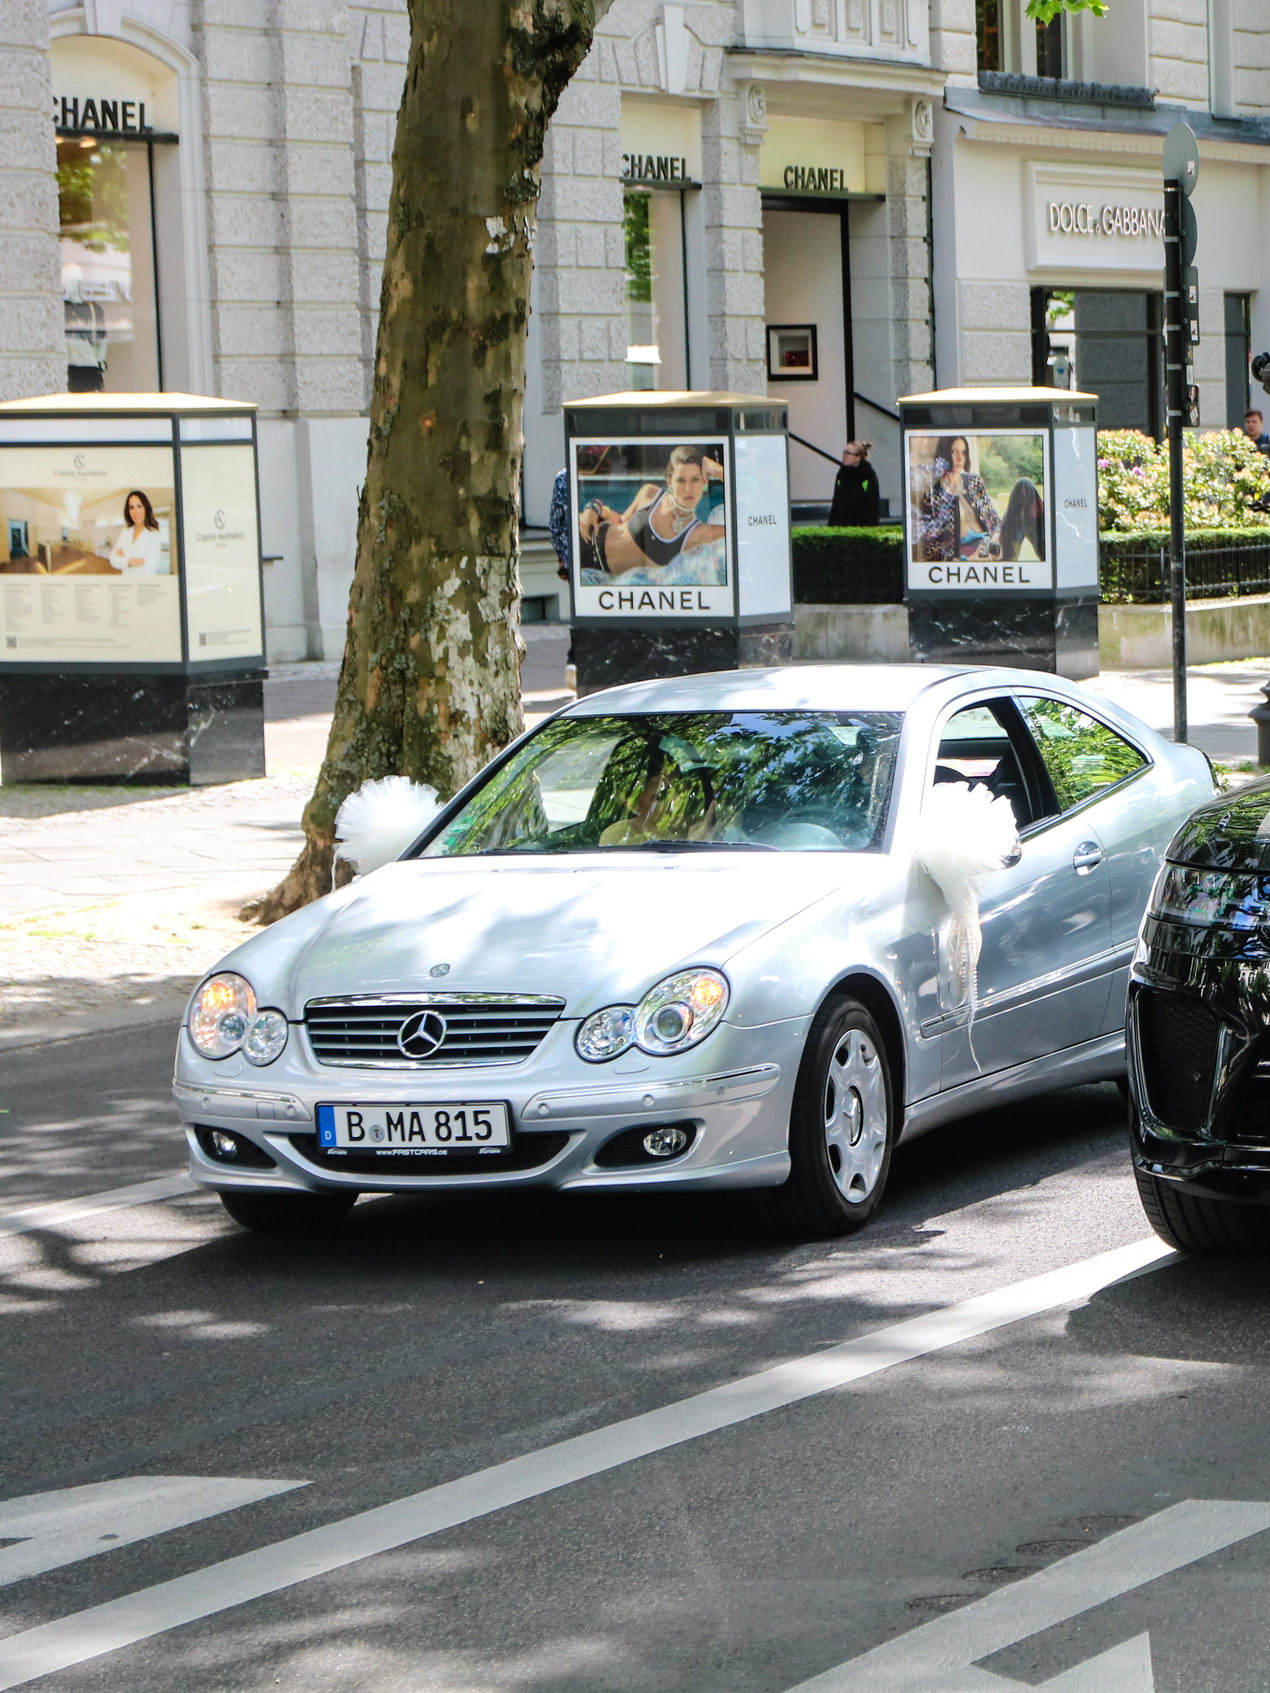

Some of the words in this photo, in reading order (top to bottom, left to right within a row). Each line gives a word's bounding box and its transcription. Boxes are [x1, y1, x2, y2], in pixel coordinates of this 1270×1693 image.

[784, 166, 849, 192] CHANEL
[1047, 203, 1094, 234] DOLCE
[1063, 499, 1088, 508] CHANEL
[747, 515, 777, 526] CHANEL
[928, 566, 1030, 583] CHANEL
[598, 591, 711, 610] CHANEL
[324, 1130, 332, 1140] D
[346, 1111, 365, 1142] B
[385, 1111, 426, 1142] MA
[434, 1110, 493, 1142] 815
